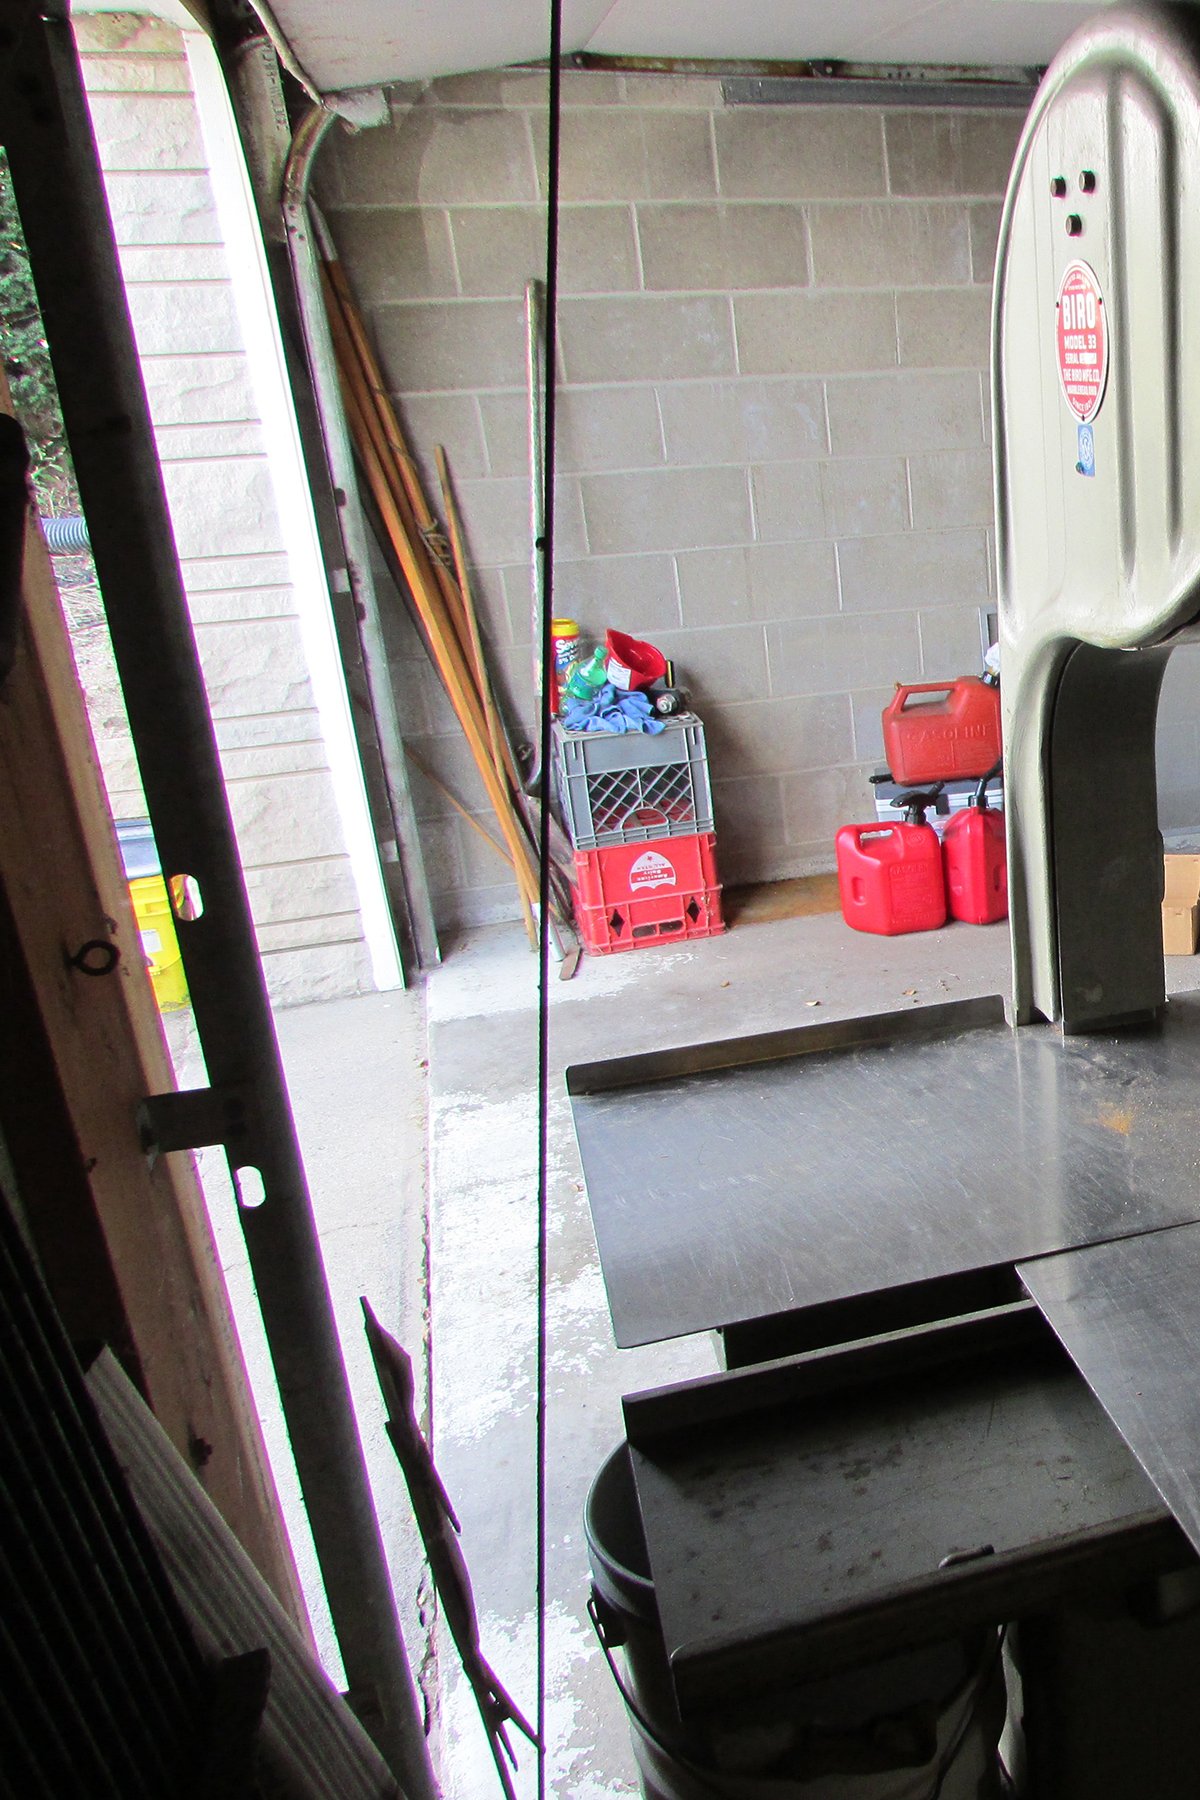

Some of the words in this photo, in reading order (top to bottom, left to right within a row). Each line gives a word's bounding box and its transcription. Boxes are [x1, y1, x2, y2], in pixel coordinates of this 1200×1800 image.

[1062, 292, 1096, 330] BIRO
[1064, 335, 1087, 350] MODEL
[1088, 334, 1097, 350] 33
